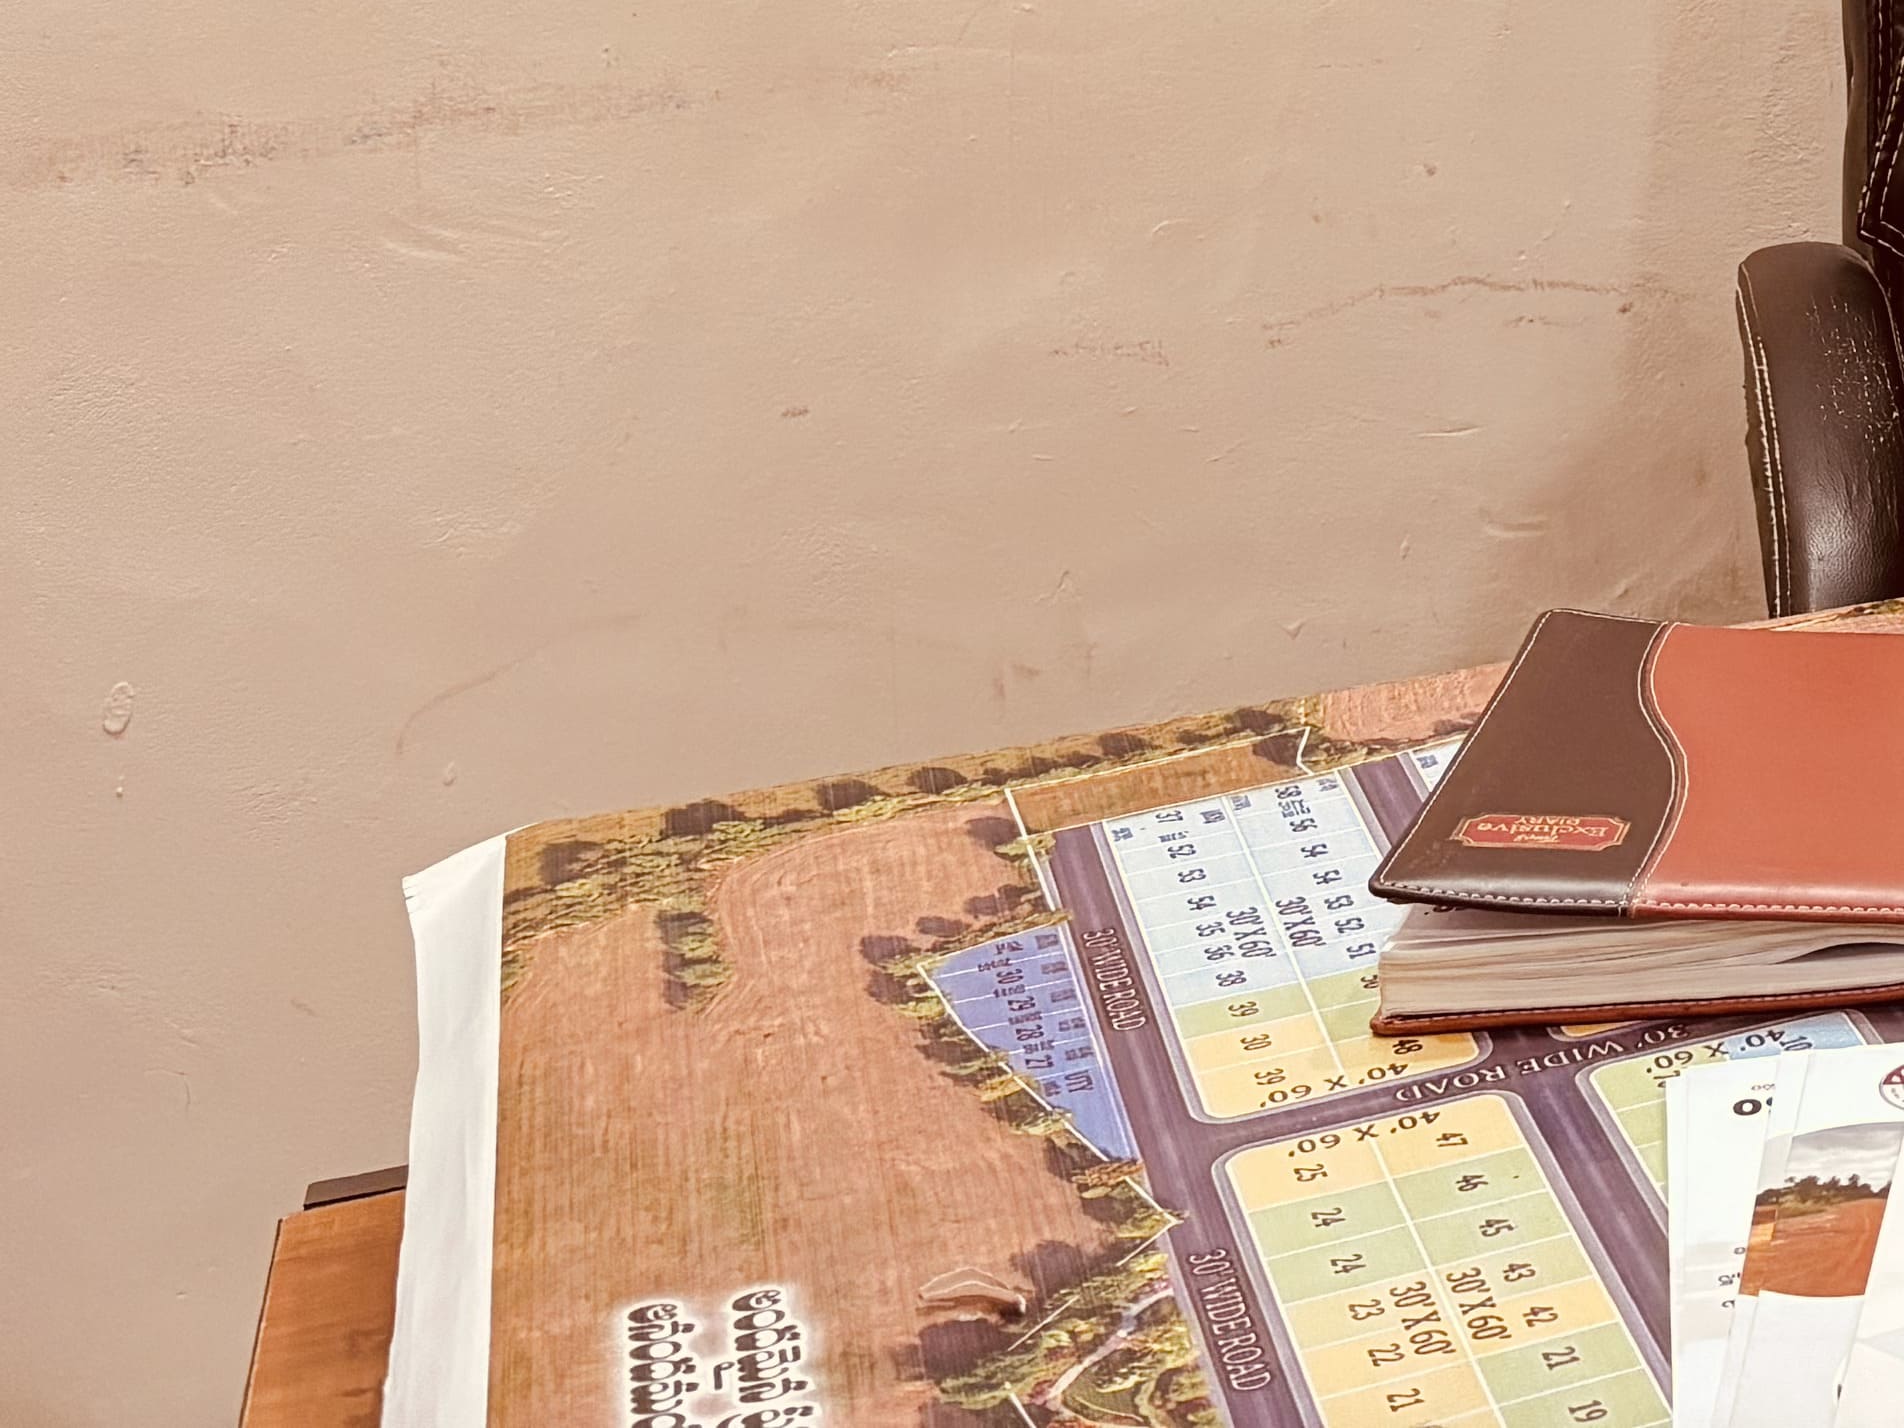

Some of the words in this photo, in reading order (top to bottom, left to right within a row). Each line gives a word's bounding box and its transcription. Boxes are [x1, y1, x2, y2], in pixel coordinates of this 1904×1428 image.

[1476, 822, 1609, 837] Exclusive
[1334, 917, 1365, 934] 52
[1346, 942, 1376, 959] 51
[1091, 949, 1134, 990] WIDE
[1103, 985, 1147, 1031] ROAD
[1227, 1001, 1259, 1017] 39
[1239, 1033, 1272, 1051] 30
[1392, 1039, 1424, 1055] 48
[1519, 1044, 1624, 1077] WIDE
[1254, 1068, 1286, 1085] 39
[1394, 1066, 1512, 1102] ROAD
[1287, 1133, 1341, 1158] 60'
[1435, 1132, 1469, 1148] 47
[1292, 1163, 1328, 1183] 25
[1455, 1174, 1489, 1192] 46
[1309, 1206, 1347, 1228] 24
[1478, 1217, 1516, 1237] 45
[1329, 1253, 1368, 1274] 24
[1501, 1261, 1537, 1283] 43
[1204, 1276, 1249, 1333] WIDE
[1347, 1298, 1386, 1321] 23
[1521, 1304, 1559, 1328] 42
[1222, 1334, 1271, 1391] ROAD
[1367, 1342, 1406, 1368] 22
[1541, 1346, 1581, 1370] 21
[1385, 1387, 1425, 1413] 21
[1567, 1398, 1609, 1423] 19
